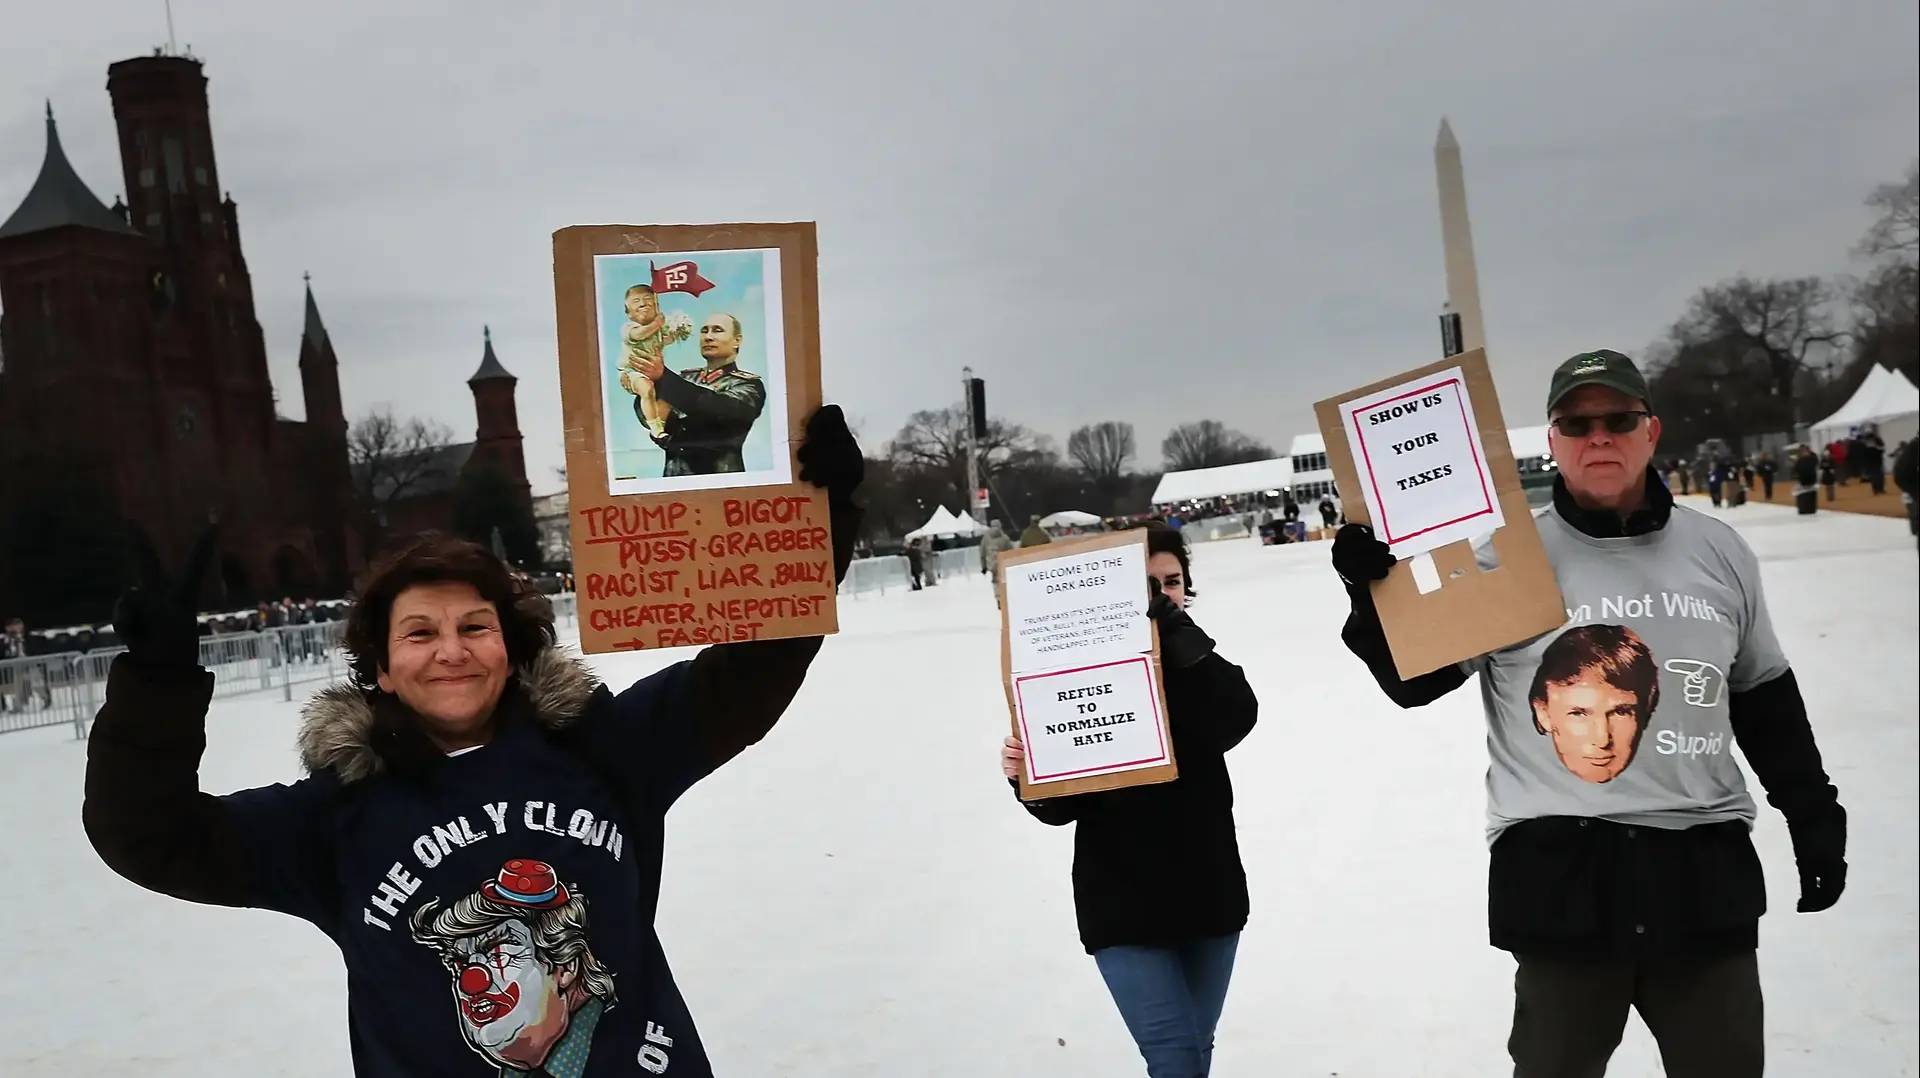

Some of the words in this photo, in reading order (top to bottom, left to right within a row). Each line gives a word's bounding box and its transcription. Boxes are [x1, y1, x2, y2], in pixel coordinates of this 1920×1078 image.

[1369, 401, 1419, 426] SHOW
[1422, 393, 1443, 408] US
[1392, 432, 1439, 455] YOUR
[1397, 464, 1453, 491] TAXES
[723, 496, 811, 526] BIGOT,
[1028, 564, 1082, 582] WELCOME
[1085, 561, 1099, 572] TO
[1103, 557, 1123, 569] THE
[1046, 581, 1076, 595] DARK
[1079, 575, 1106, 588] AGES
[706, 594, 827, 621] NEPOTIST
[1024, 614, 1050, 625] TRUMP
[1051, 611, 1069, 621] SAYS
[1109, 600, 1134, 611] GROPE
[1102, 613, 1122, 622] MAKE
[1601, 593, 1654, 619] Not
[1661, 592, 1721, 622] With
[657, 622, 764, 648] FASCIST
[1057, 684, 1113, 702] REFUSE
[1077, 702, 1097, 714] TO
[1045, 712, 1136, 735] NORMALIZE
[1073, 731, 1113, 746] HATE
[1655, 729, 1723, 760] Stupid
[363, 861, 422, 931] THE
[413, 802, 508, 868] ONLY
[637, 1020, 673, 1075] OF
